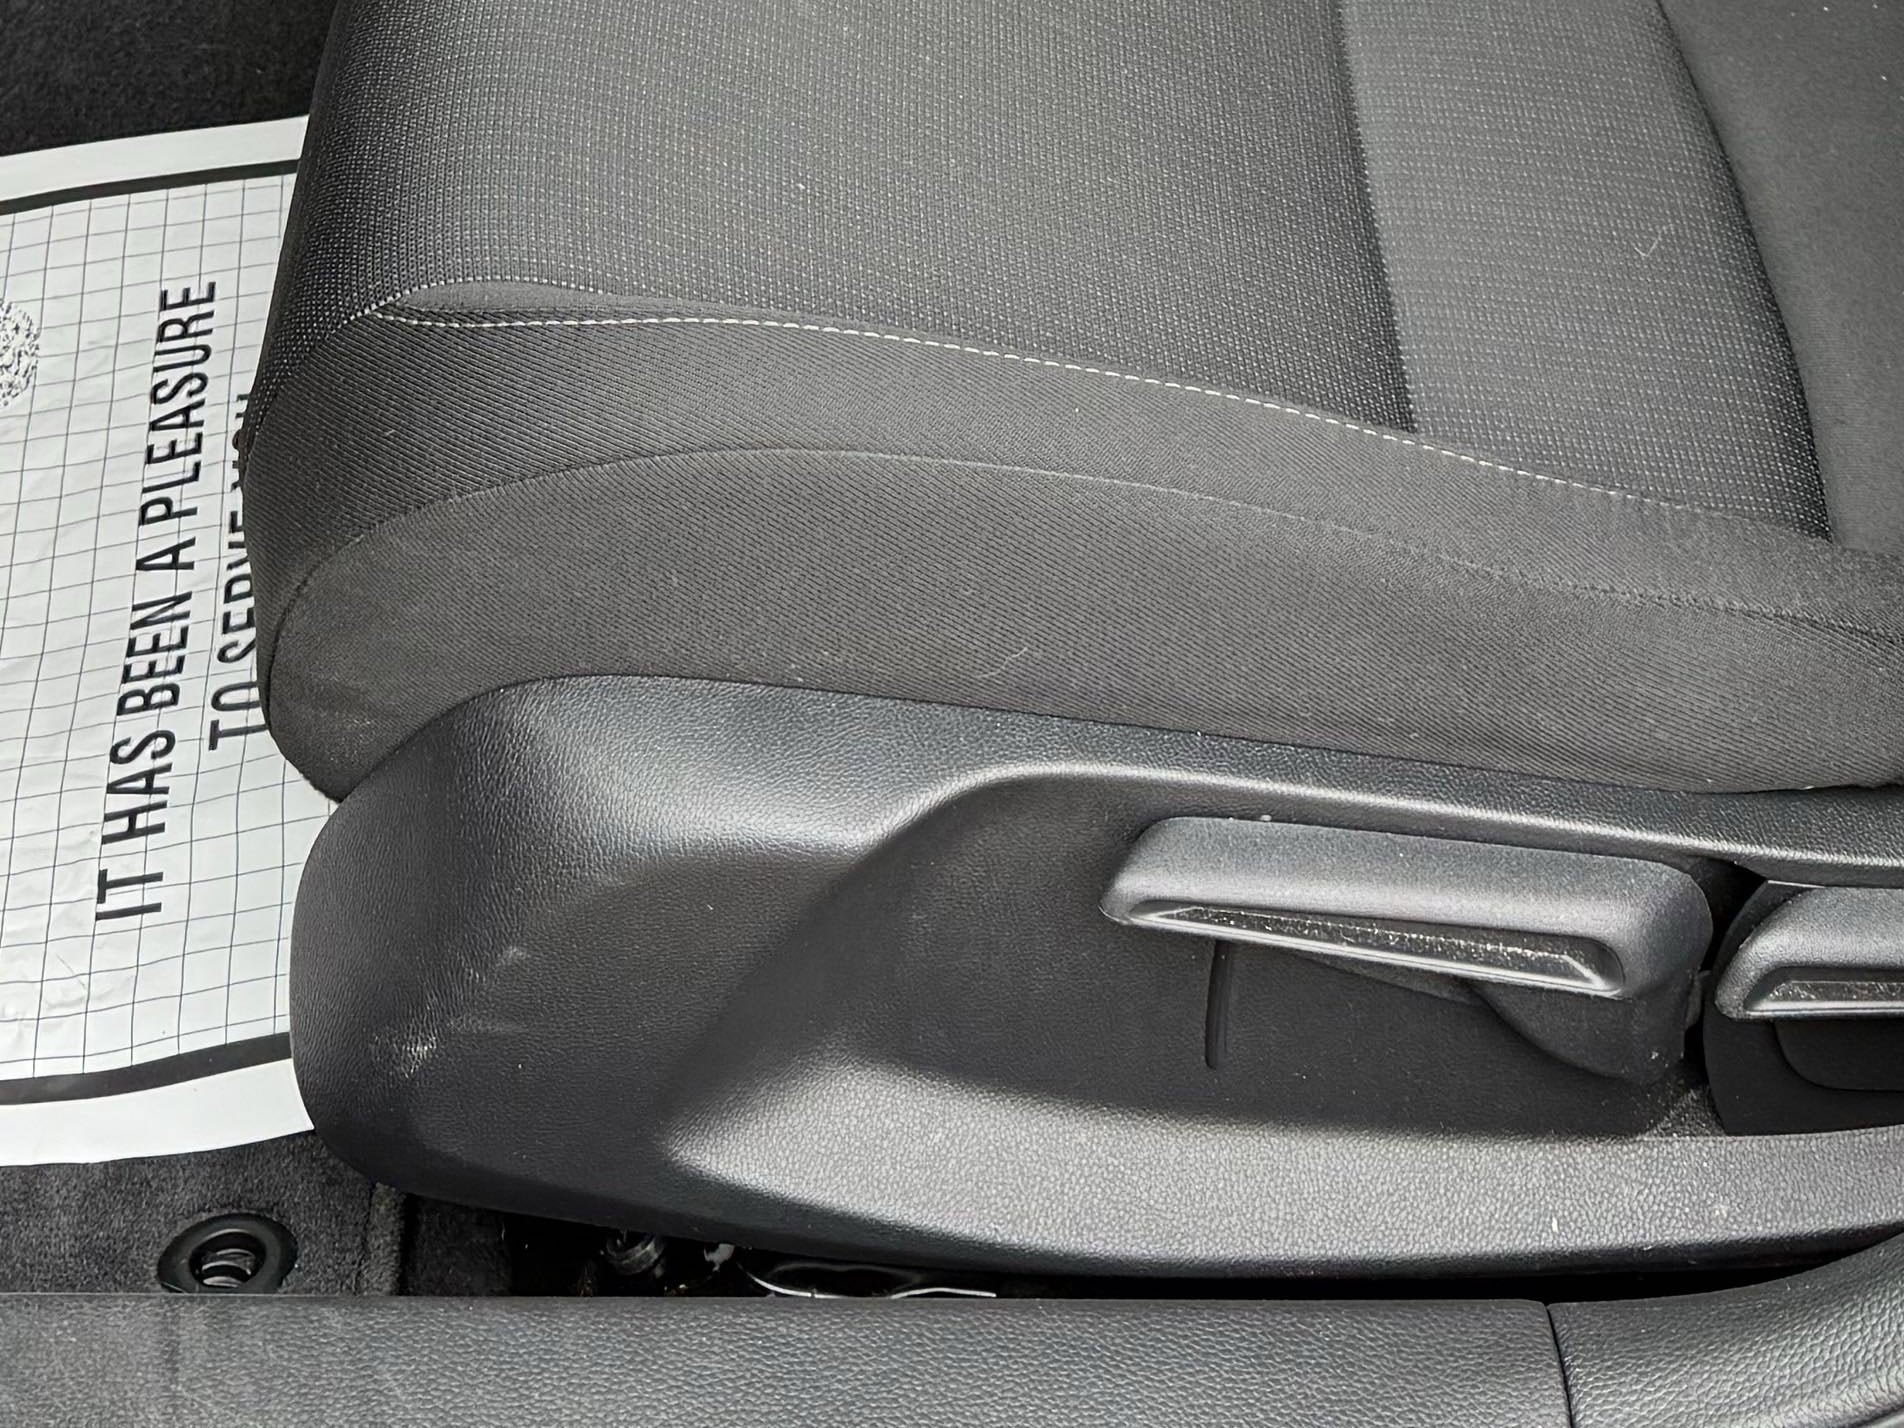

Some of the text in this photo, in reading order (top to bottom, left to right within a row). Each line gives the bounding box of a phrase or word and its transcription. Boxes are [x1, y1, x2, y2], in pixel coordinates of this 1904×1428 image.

[95, 282, 216, 921] IT HAS BEEN A PLEASURE
[209, 680, 268, 751] TO
